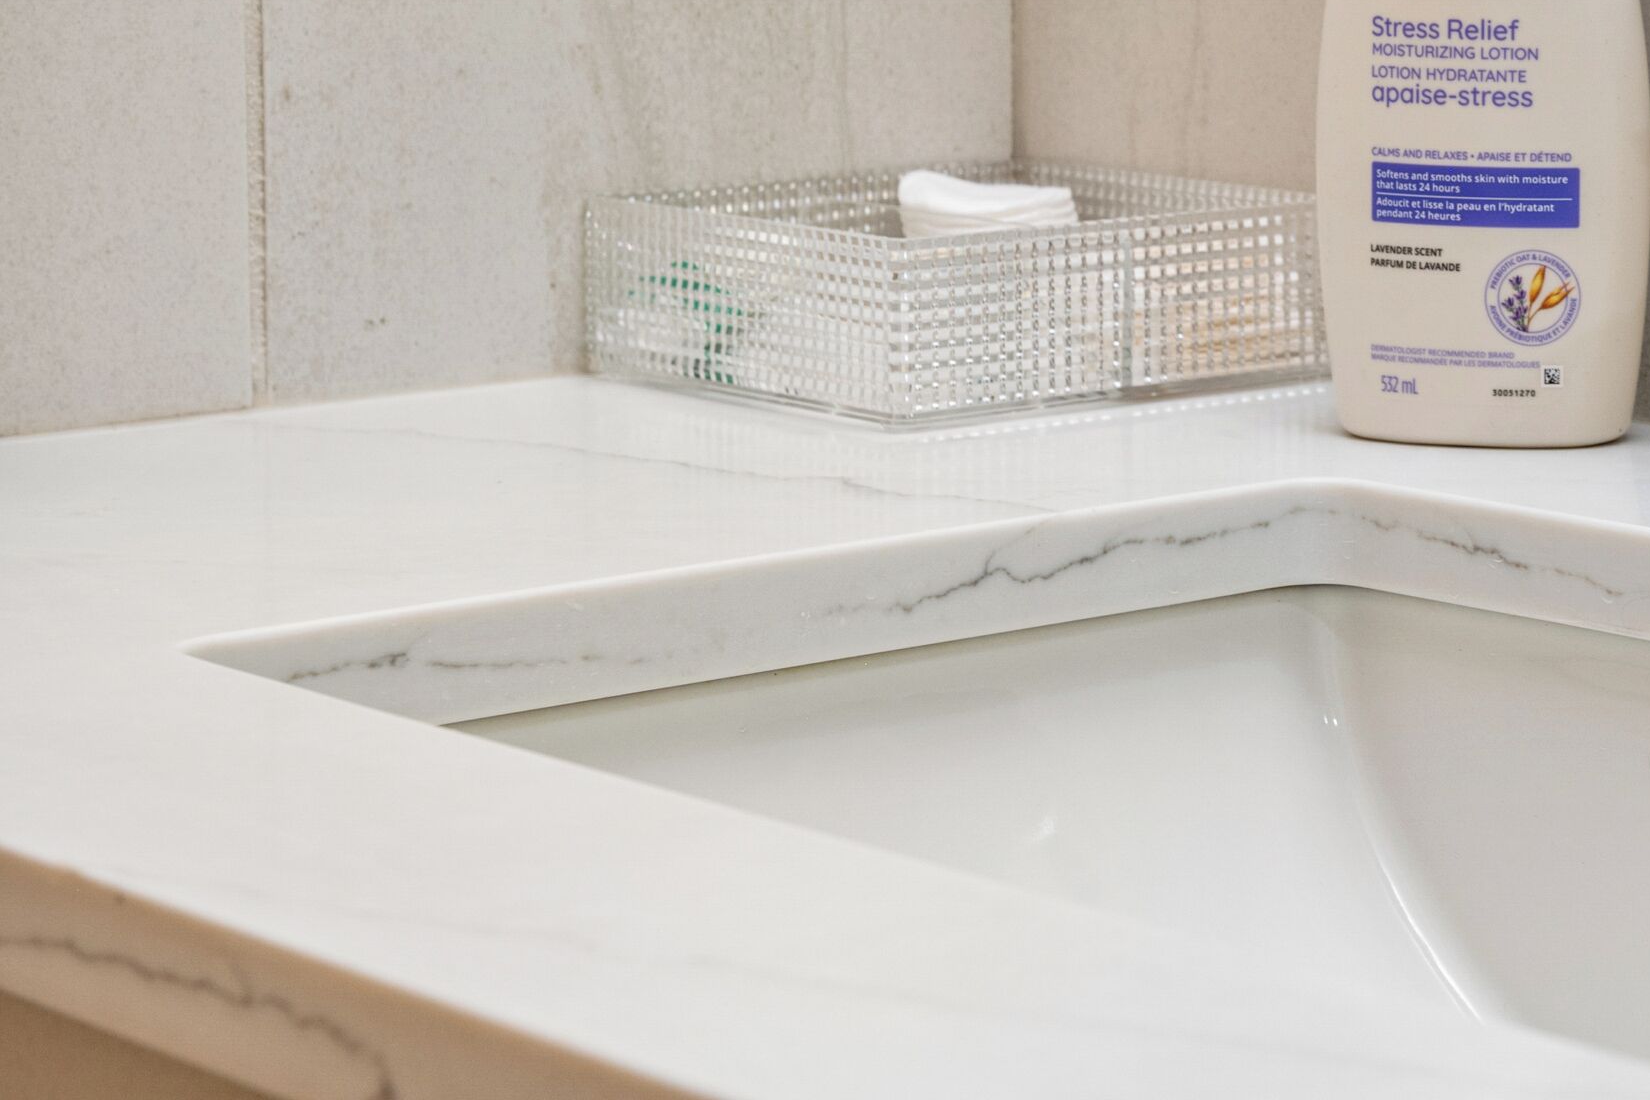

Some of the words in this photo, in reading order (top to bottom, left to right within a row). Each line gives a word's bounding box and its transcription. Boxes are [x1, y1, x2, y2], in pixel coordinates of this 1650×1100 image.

[1371, 15, 1440, 40] Stress
[1447, 19, 1519, 41] Relief
[1372, 43, 1476, 60] MOISTURIZING
[1480, 47, 1539, 61] LOTION
[1371, 65, 1421, 80] LOTION
[1426, 68, 1527, 83] HYDRATANTE
[1371, 84, 1534, 108] apaise-stress
[1372, 146, 1401, 158] CALMS
[1403, 149, 1423, 159] AND
[1425, 150, 1468, 161] RELAXES
[1477, 153, 1512, 162] APAISE
[1515, 153, 1527, 162] ET
[1530, 150, 1572, 163] DÉTEND
[1376, 169, 1409, 181] Softens
[1411, 172, 1429, 181] and
[1430, 172, 1472, 183] smooths
[1474, 173, 1496, 183] skin
[1497, 174, 1520, 184] with
[1522, 174, 1568, 185] moisture
[1376, 180, 1394, 190] that
[1396, 181, 1417, 192] lasts
[1419, 183, 1431, 192] 24
[1432, 183, 1461, 194] hours
[1376, 197, 1410, 209] Adoucit
[1412, 200, 1422, 208] et
[1423, 200, 1444, 209] lisse
[1446, 201, 1455, 210] la
[1457, 203, 1481, 214] peau
[1483, 203, 1496, 211] en
[1376, 209, 1413, 221] pendant
[1414, 210, 1427, 220] 24
[1428, 211, 1461, 221] heures
[1370, 244, 1413, 255] LAVENDER
[1415, 247, 1442, 257] SCENT
[1370, 257, 1404, 270] PARFUM
[1406, 261, 1417, 270] DE
[1419, 261, 1461, 272] LAVANDE
[1490, 258, 1517, 289] PREBIOTIC
[1516, 254, 1530, 262] OAT
[1539, 254, 1571, 278] LAVENDER
[1428, 348, 1486, 358] RECOMMENDED
[1381, 374, 1399, 393] 532
